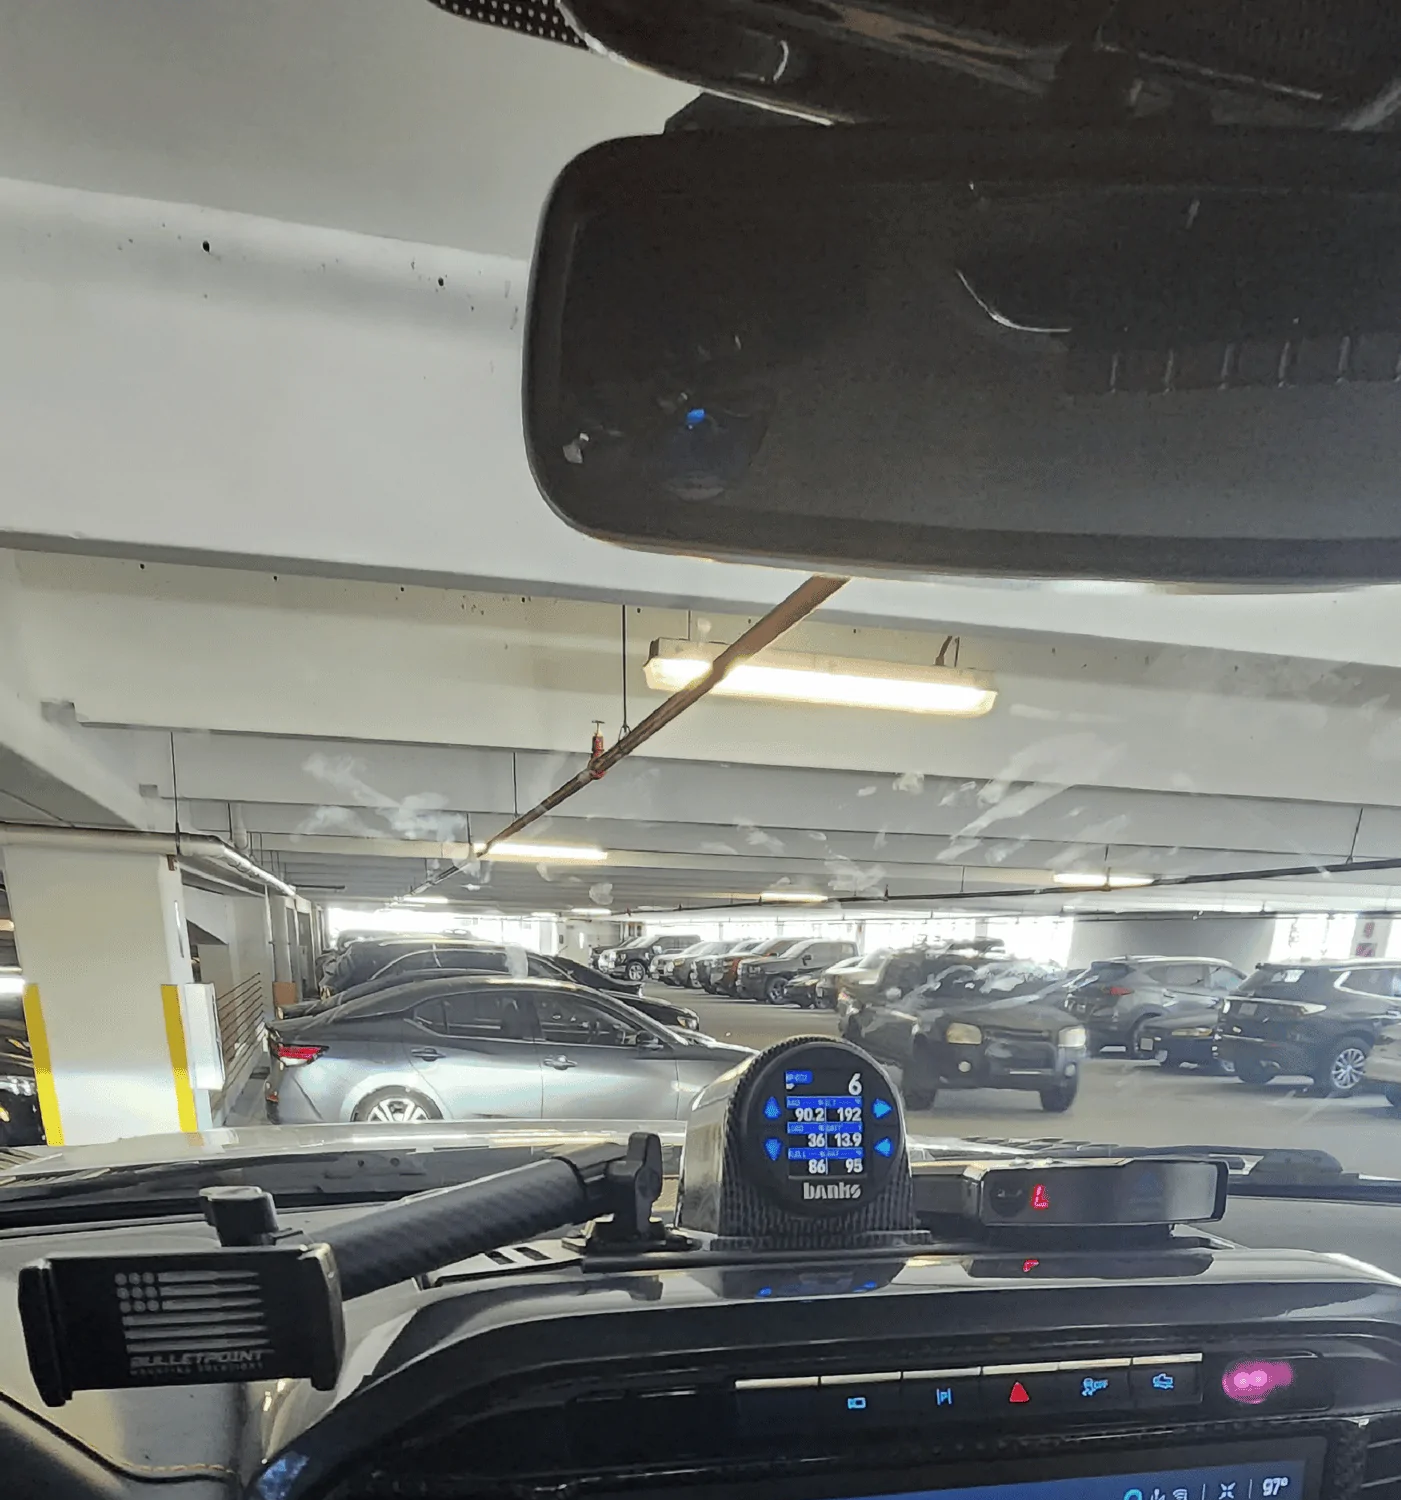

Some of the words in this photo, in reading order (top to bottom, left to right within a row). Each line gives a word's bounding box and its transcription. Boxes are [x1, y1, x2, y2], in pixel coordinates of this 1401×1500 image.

[848, 1072, 862, 1096] 6
[795, 1107, 825, 1122] 90.2
[837, 1106, 862, 1122] 192
[807, 1132, 825, 1148] 36
[834, 1132, 862, 1148] 13.9
[808, 1159, 825, 1174] 86
[845, 1158, 863, 1173] 95
[803, 1181, 862, 1200] banks
[130, 1349, 270, 1367] BULLETPOINT
